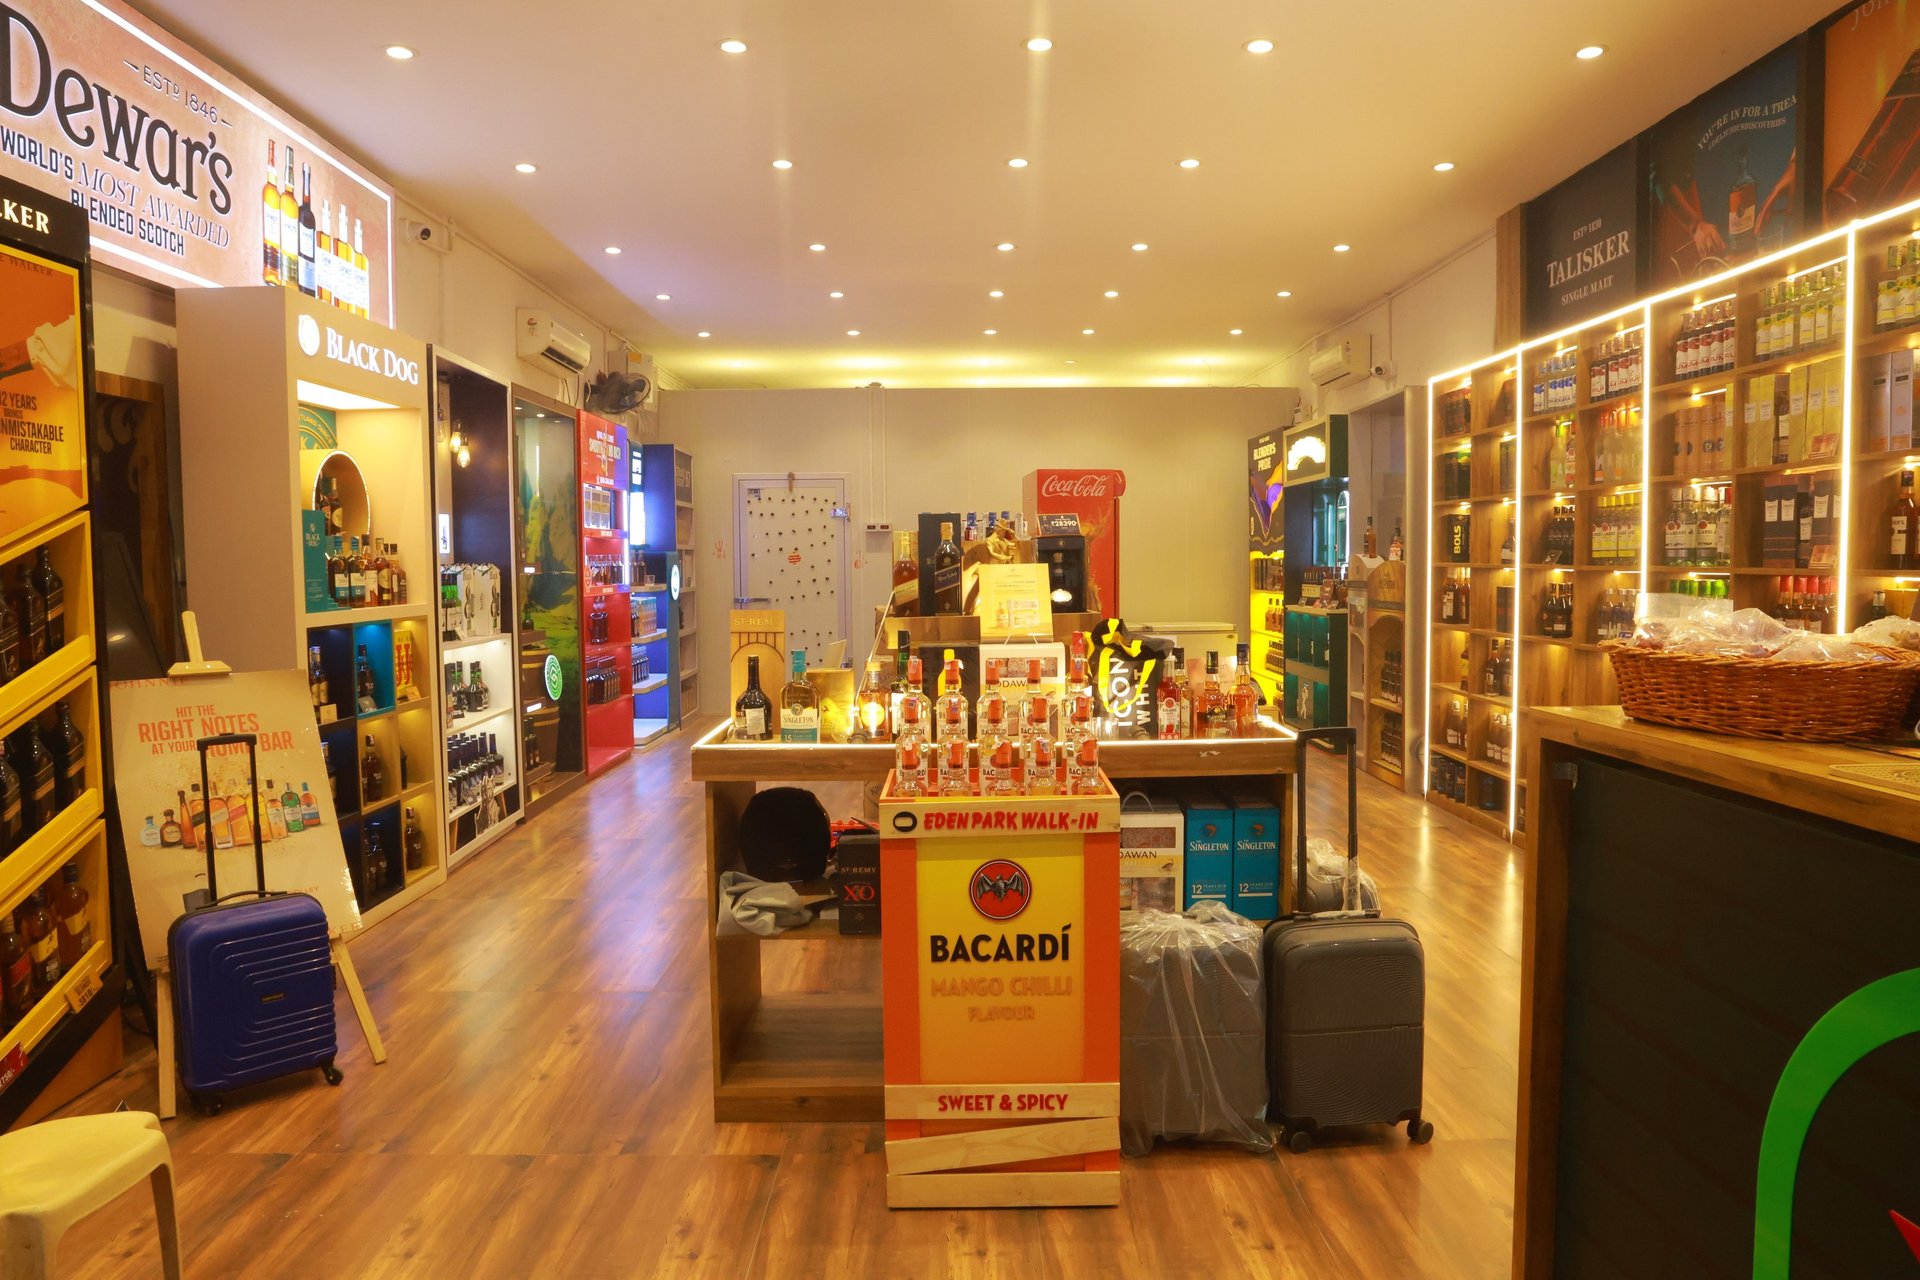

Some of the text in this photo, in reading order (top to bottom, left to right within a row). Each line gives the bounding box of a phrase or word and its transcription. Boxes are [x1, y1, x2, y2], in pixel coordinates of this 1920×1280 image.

[0, 8, 233, 216] Dewar's
[185, 91, 218, 123] 1846
[1697, 113, 1728, 150] YOU'RE
[1730, 107, 1740, 121] IN
[1742, 106, 1760, 117] FOR
[1762, 105, 1769, 116] A
[2, 126, 73, 180] WORLD'S
[78, 163, 140, 207] MOST
[146, 194, 229, 248] AWARDED
[0, 198, 49, 234] KER
[71, 189, 185, 256] BLENDED SCOTCH
[1547, 230, 1630, 288] TALISKER
[1561, 275, 1613, 306] SINGLE MALT
[326, 326, 418, 385] BLACK DOG
[9, 392, 37, 411] YEARS
[10, 437, 52, 455] CHARACTER
[1042, 474, 1110, 498] Coca-Cola
[1453, 525, 1462, 554] BOLS
[1108, 657, 1133, 727] ICON
[1133, 668, 1152, 726] WHIT
[176, 704, 215, 718] HIT THE
[783, 714, 814, 723] SINGLETON
[138, 713, 260, 743] RIGHT NOTES
[152, 743, 164, 755] AT
[168, 740, 196, 753] YOUR
[260, 731, 294, 752] BAR
[924, 811, 1099, 830] EDEN PARK WALK-IN
[1119, 851, 1157, 859] DAWAN
[1190, 841, 1229, 852] SINGLETON
[1237, 840, 1276, 850] SINGLETON
[844, 885, 875, 902] XO
[1192, 884, 1203, 894] 12
[1239, 883, 1249, 893] 12
[930, 923, 1072, 963] BACARDÍ
[931, 976, 1073, 997] MANGO CHILLI
[968, 1005, 1035, 1022] FLAVOUR
[938, 1094, 1068, 1112] SWEET & SPICY
